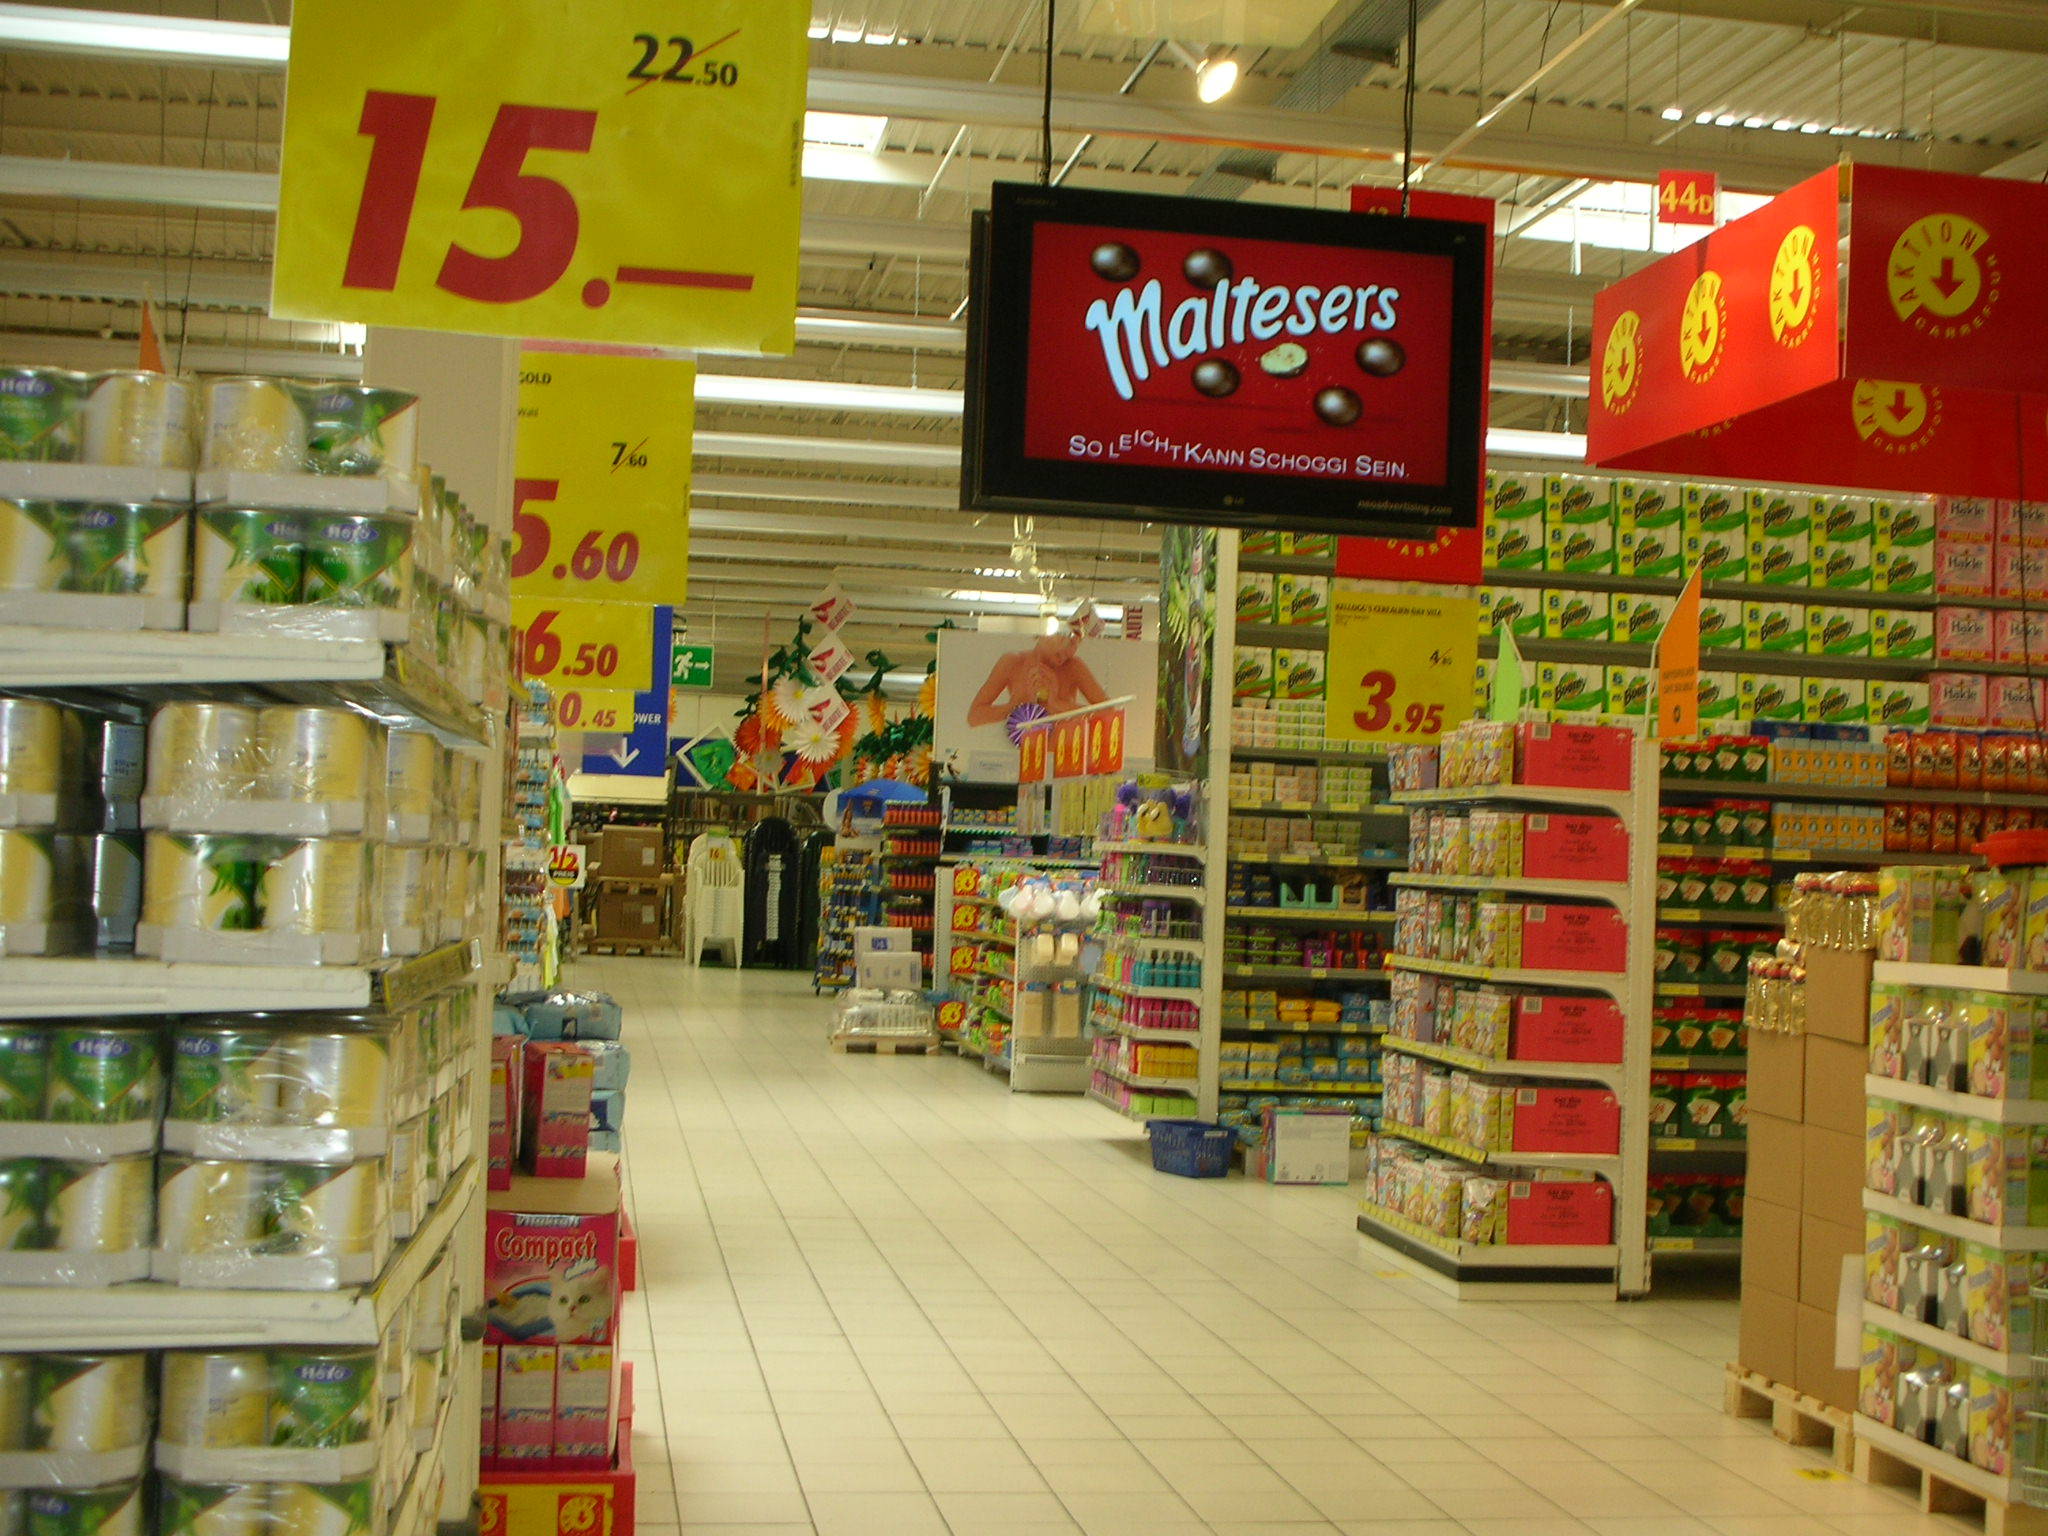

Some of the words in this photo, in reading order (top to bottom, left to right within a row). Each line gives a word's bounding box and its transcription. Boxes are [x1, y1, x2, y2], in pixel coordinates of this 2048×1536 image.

[627, 33, 739, 88] 22.50
[1773, 234, 1810, 325] AKTION
[1895, 220, 1978, 302] AKTION
[1085, 276, 1401, 401] Maltesers
[328, 523, 370, 543] Hero
[525, 610, 618, 677] 6.50
[559, 691, 617, 728] 0.45
[1353, 669, 1445, 735] 3.95
[79, 1037, 123, 1054] Hero
[496, 1226, 598, 1269] Compact
[301, 1363, 345, 1381] Hero
